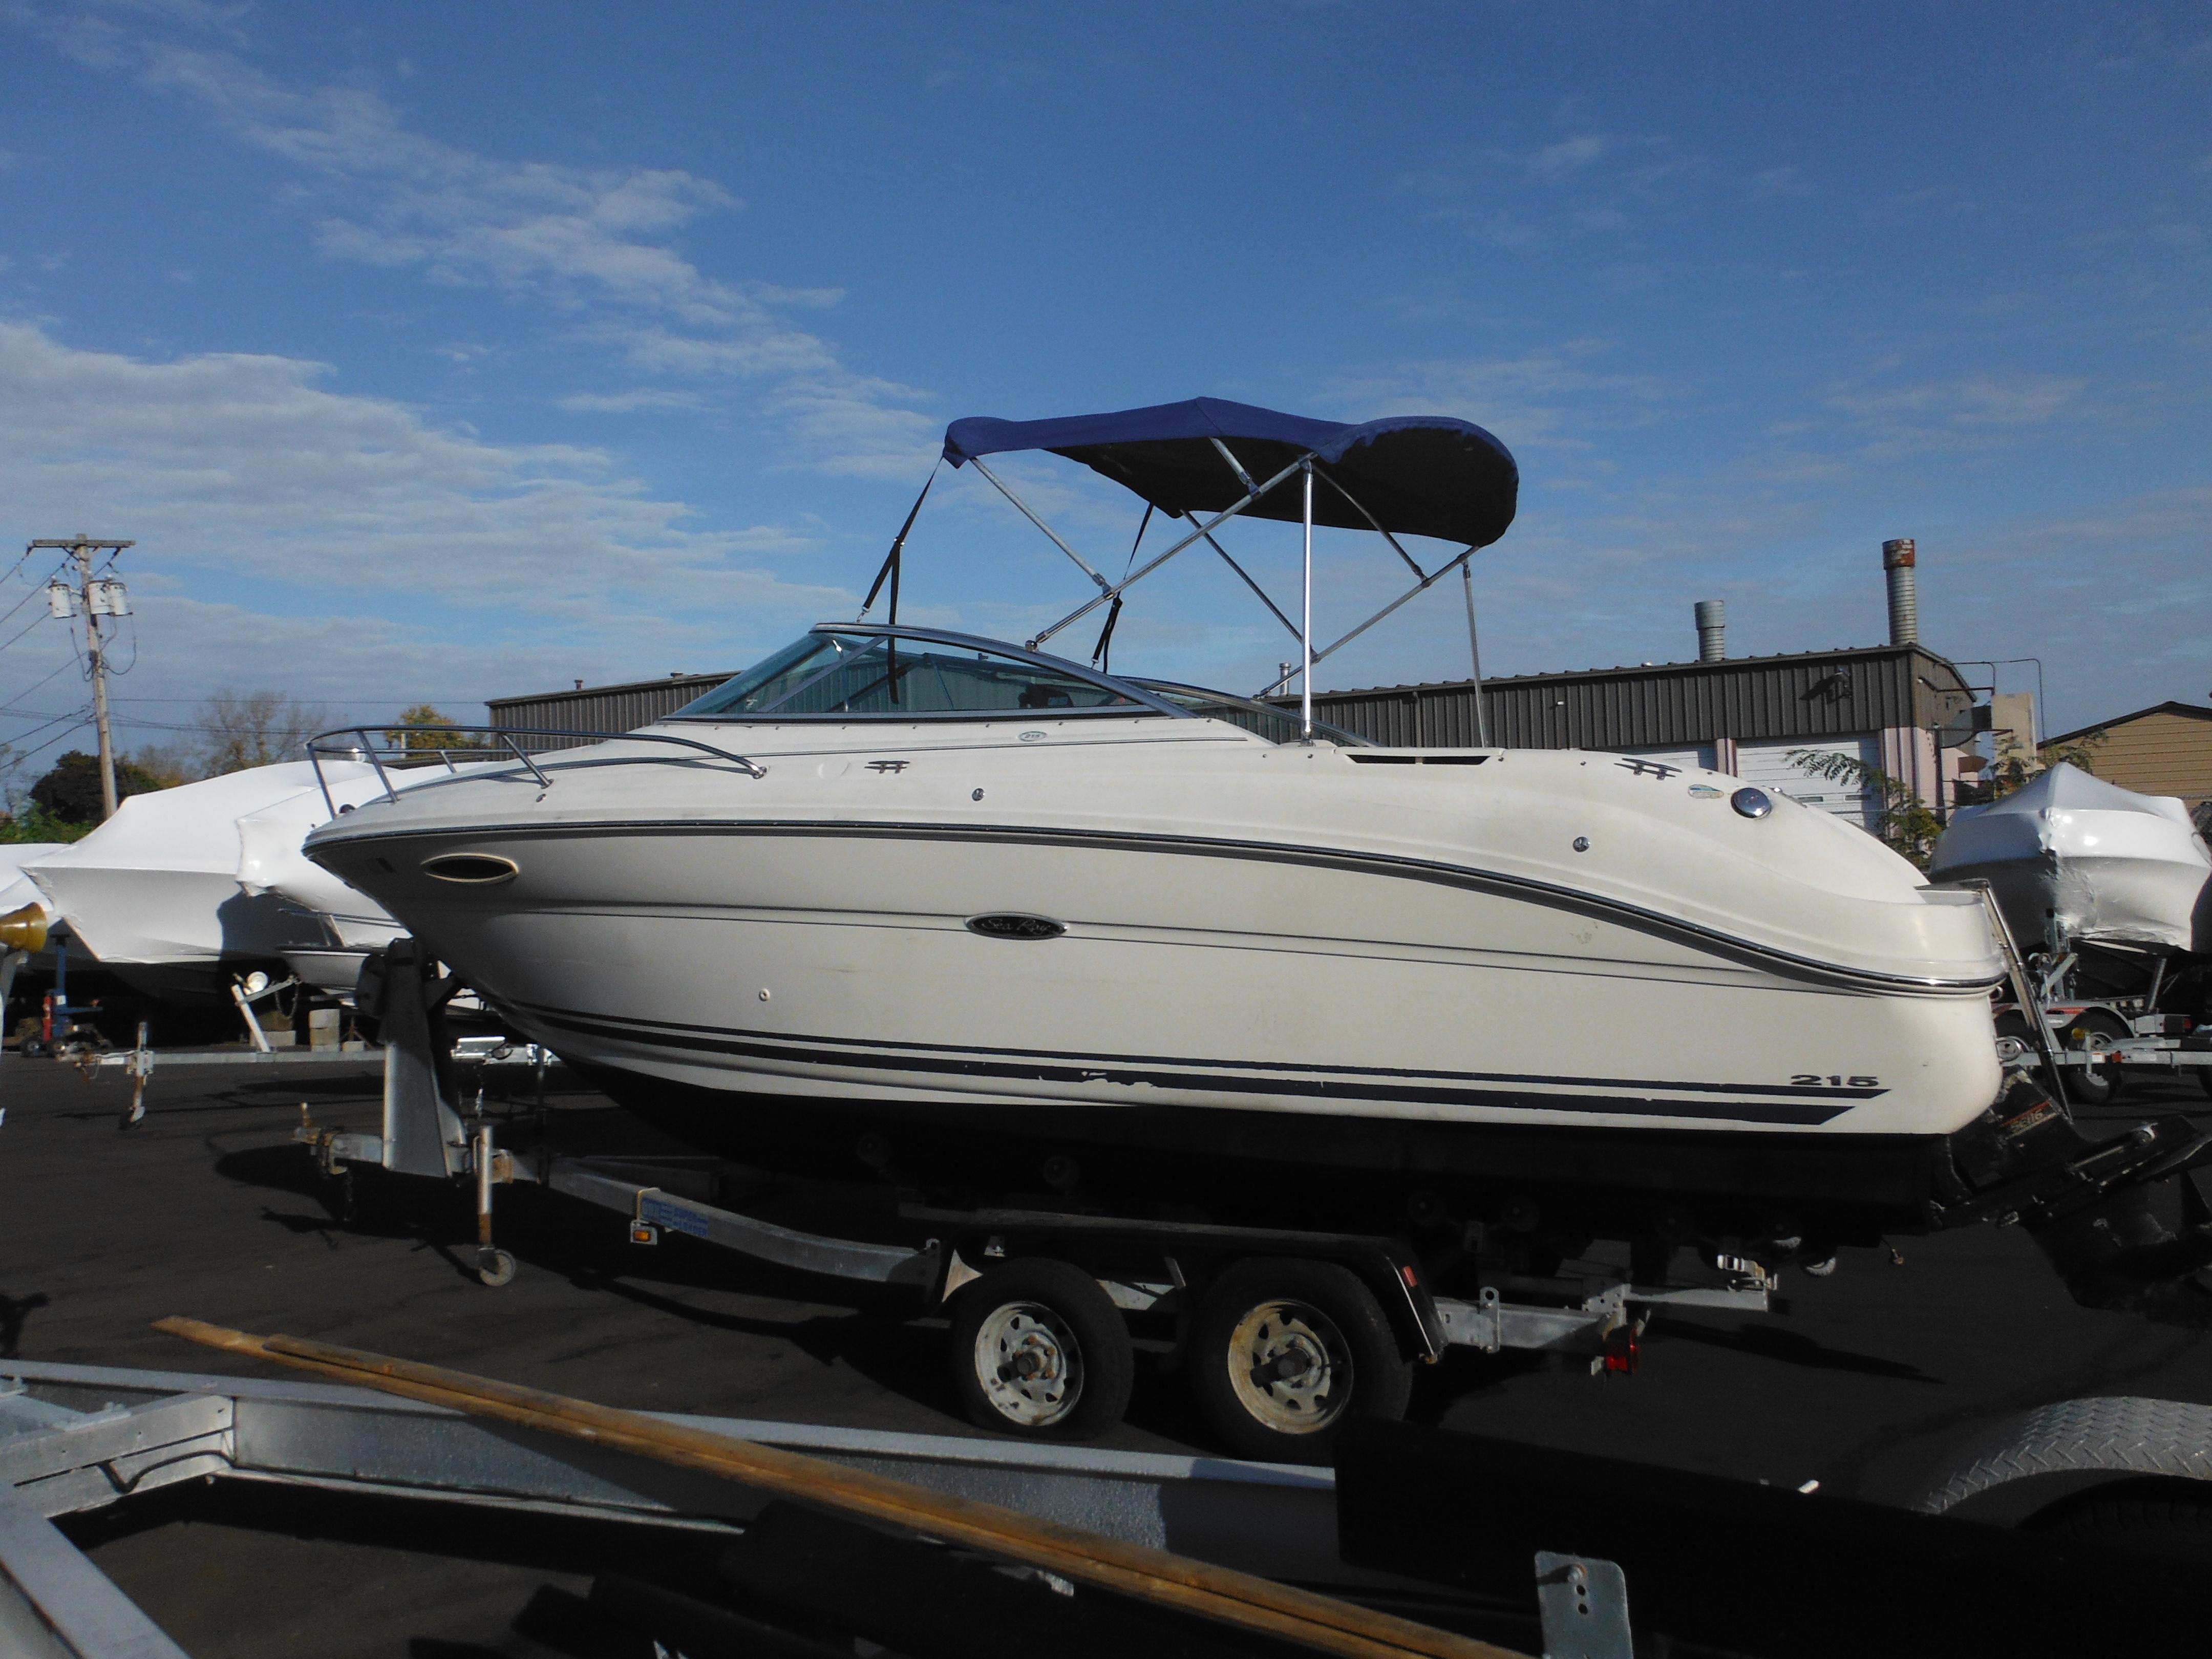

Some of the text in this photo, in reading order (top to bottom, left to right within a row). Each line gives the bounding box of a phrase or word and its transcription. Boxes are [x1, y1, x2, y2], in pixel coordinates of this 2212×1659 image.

[982, 918, 1051, 935] Sea Ray
[1791, 1074, 1879, 1087] 215
